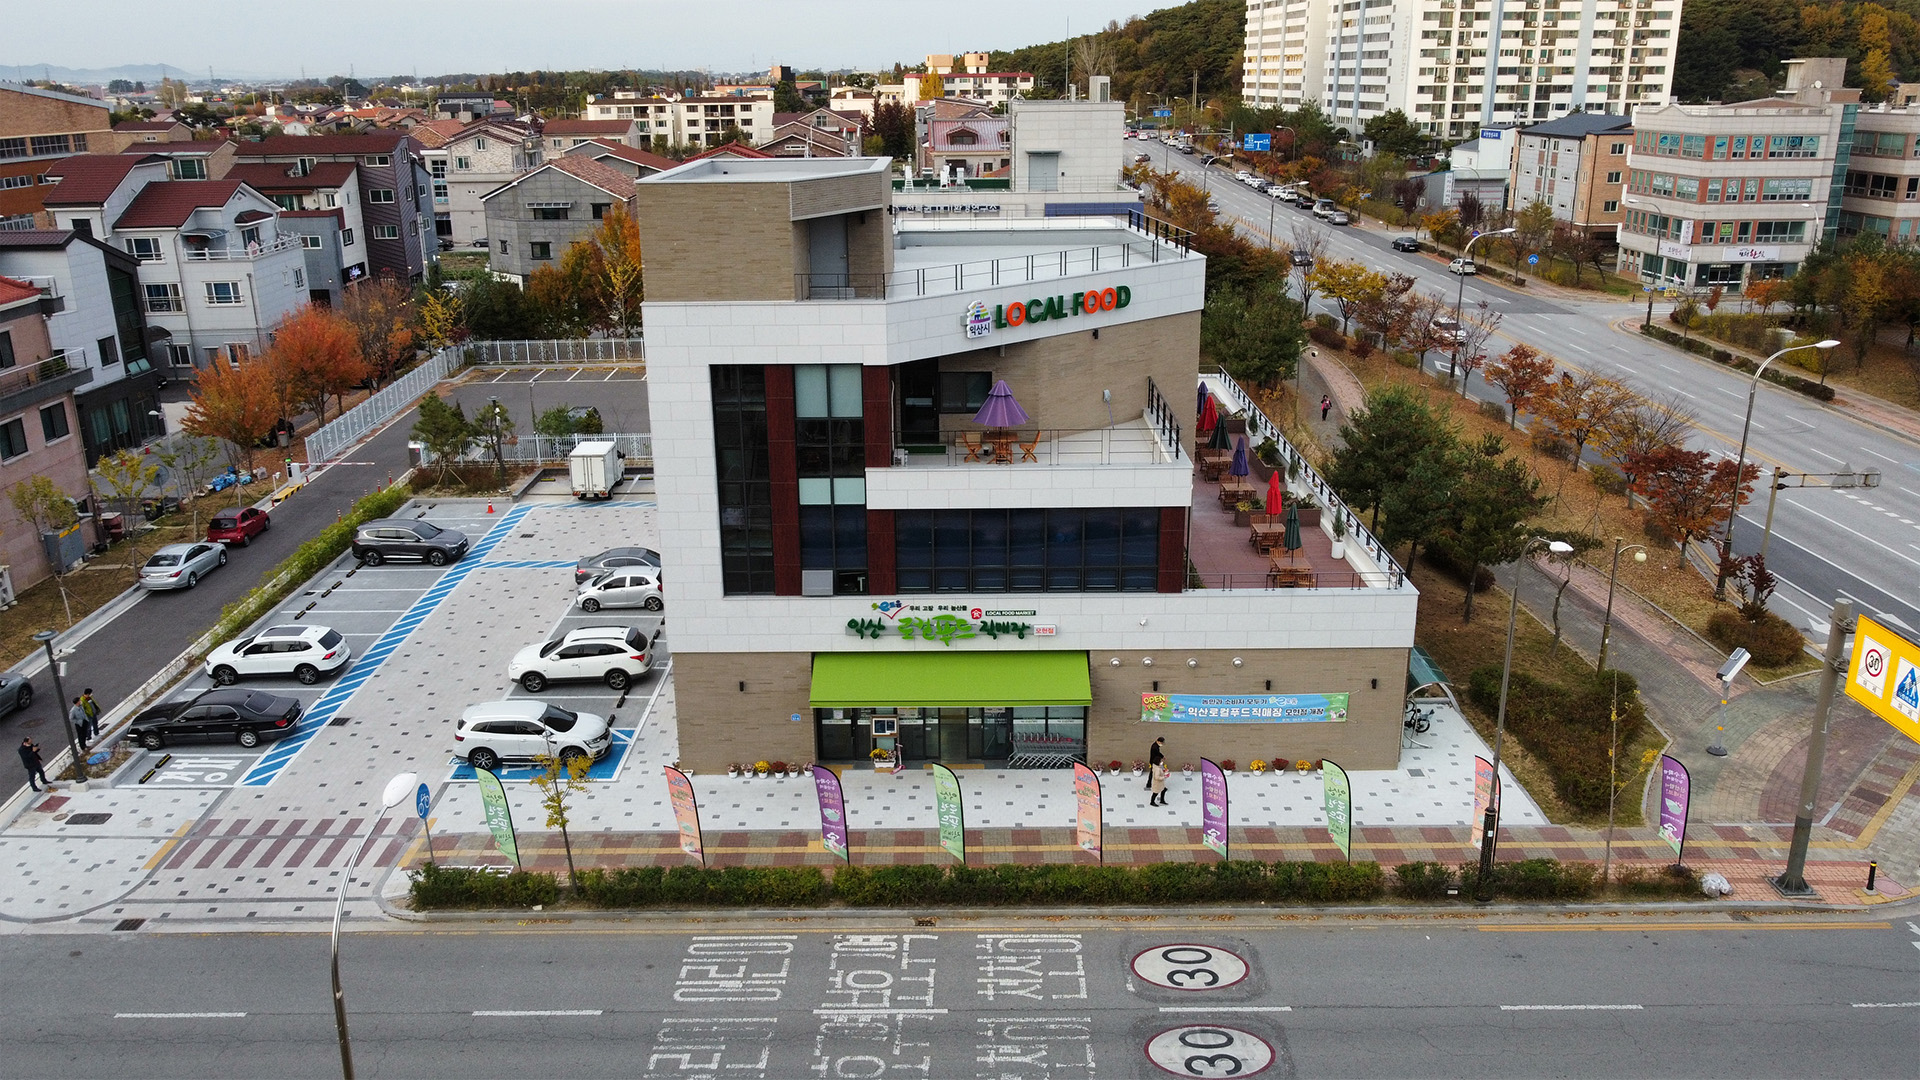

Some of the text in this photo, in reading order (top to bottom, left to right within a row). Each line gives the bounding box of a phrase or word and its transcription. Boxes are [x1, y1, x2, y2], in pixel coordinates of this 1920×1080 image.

[969, 322, 991, 336] 익산시
[996, 285, 1132, 329] LOCAL FOOD
[847, 614, 1031, 647] 익산 로컬푸드 직매장
[1868, 654, 1880, 671] 30
[1143, 695, 1166, 705] OPEN
[673, 934, 798, 1001] 어린이
[821, 934, 939, 1008] 보호구역
[976, 934, 1087, 1000] 천천히
[1162, 947, 1220, 987] 30
[643, 1017, 778, 1080] 린이
[810, 1014, 936, 1080] 호구역
[1179, 1028, 1243, 1077] 30
